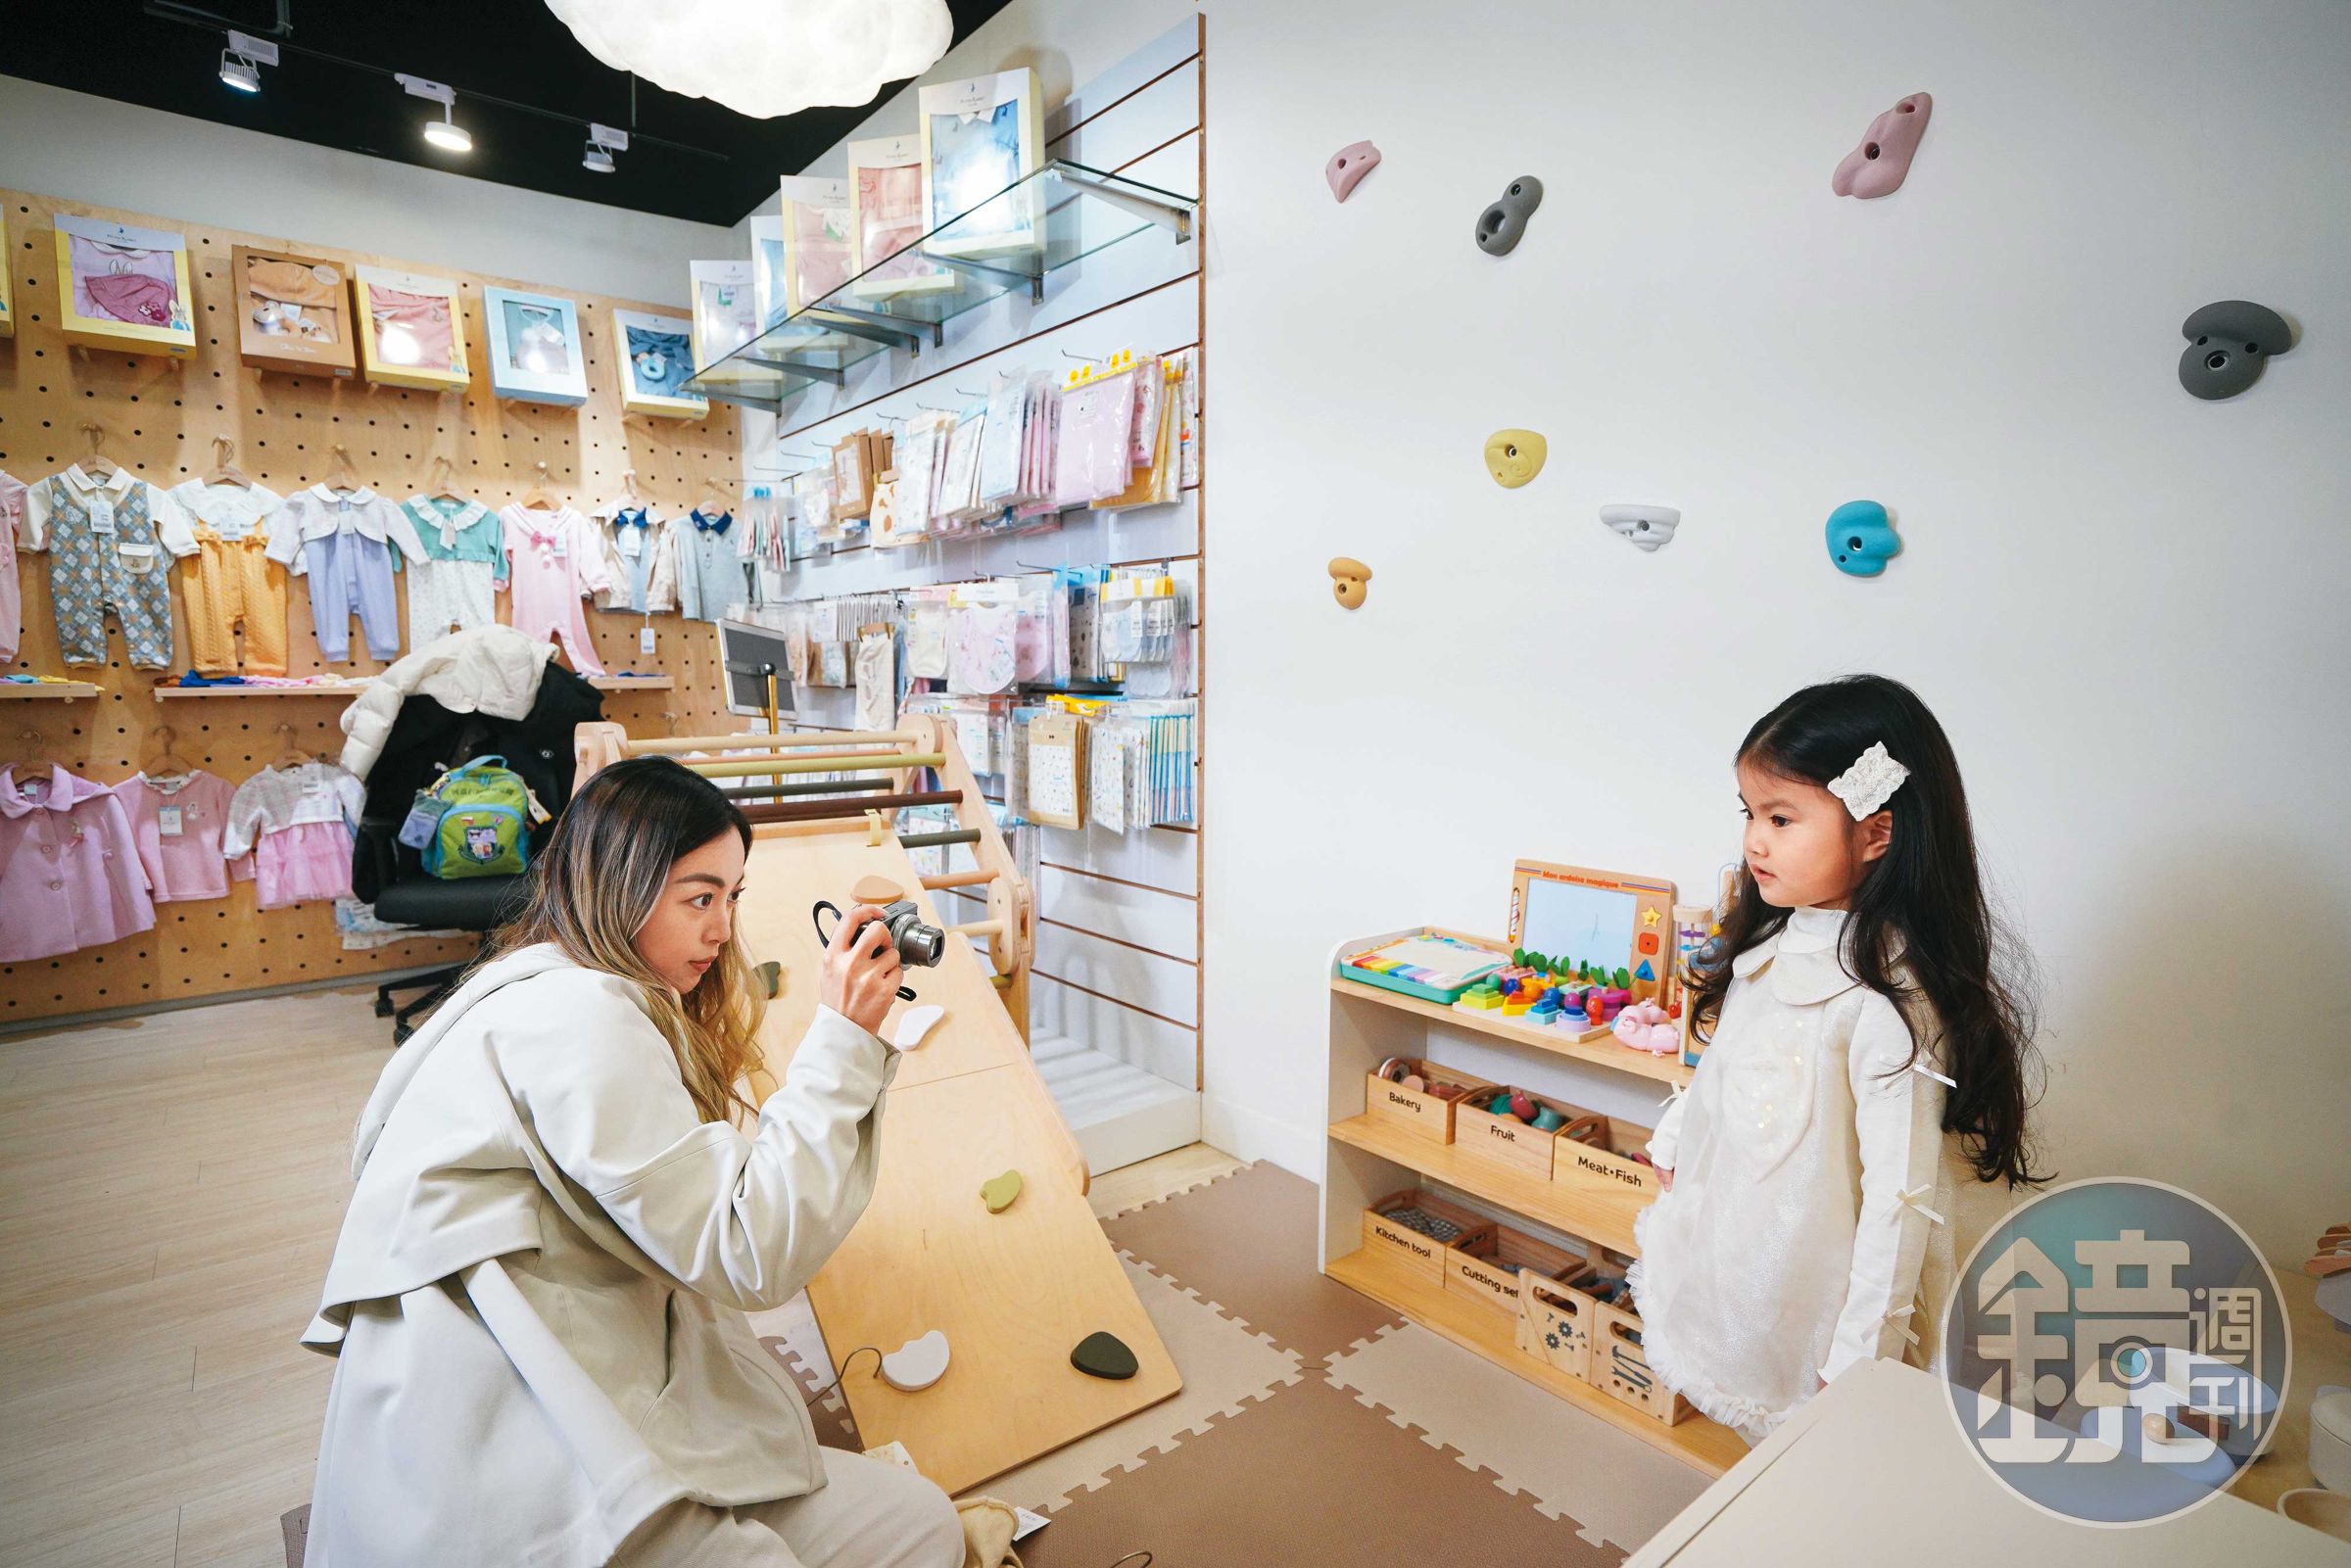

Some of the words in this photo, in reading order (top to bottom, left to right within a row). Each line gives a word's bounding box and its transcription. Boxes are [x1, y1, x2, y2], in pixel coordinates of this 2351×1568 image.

[1586, 878, 1619, 888] magique
[1389, 1091, 1421, 1113] Bakery
[1490, 1124, 1515, 1143] Fruit
[1375, 1225, 1410, 1248] Kitchen
[1412, 1243, 1431, 1259] tool
[1462, 1265, 1501, 1293] Cutting
